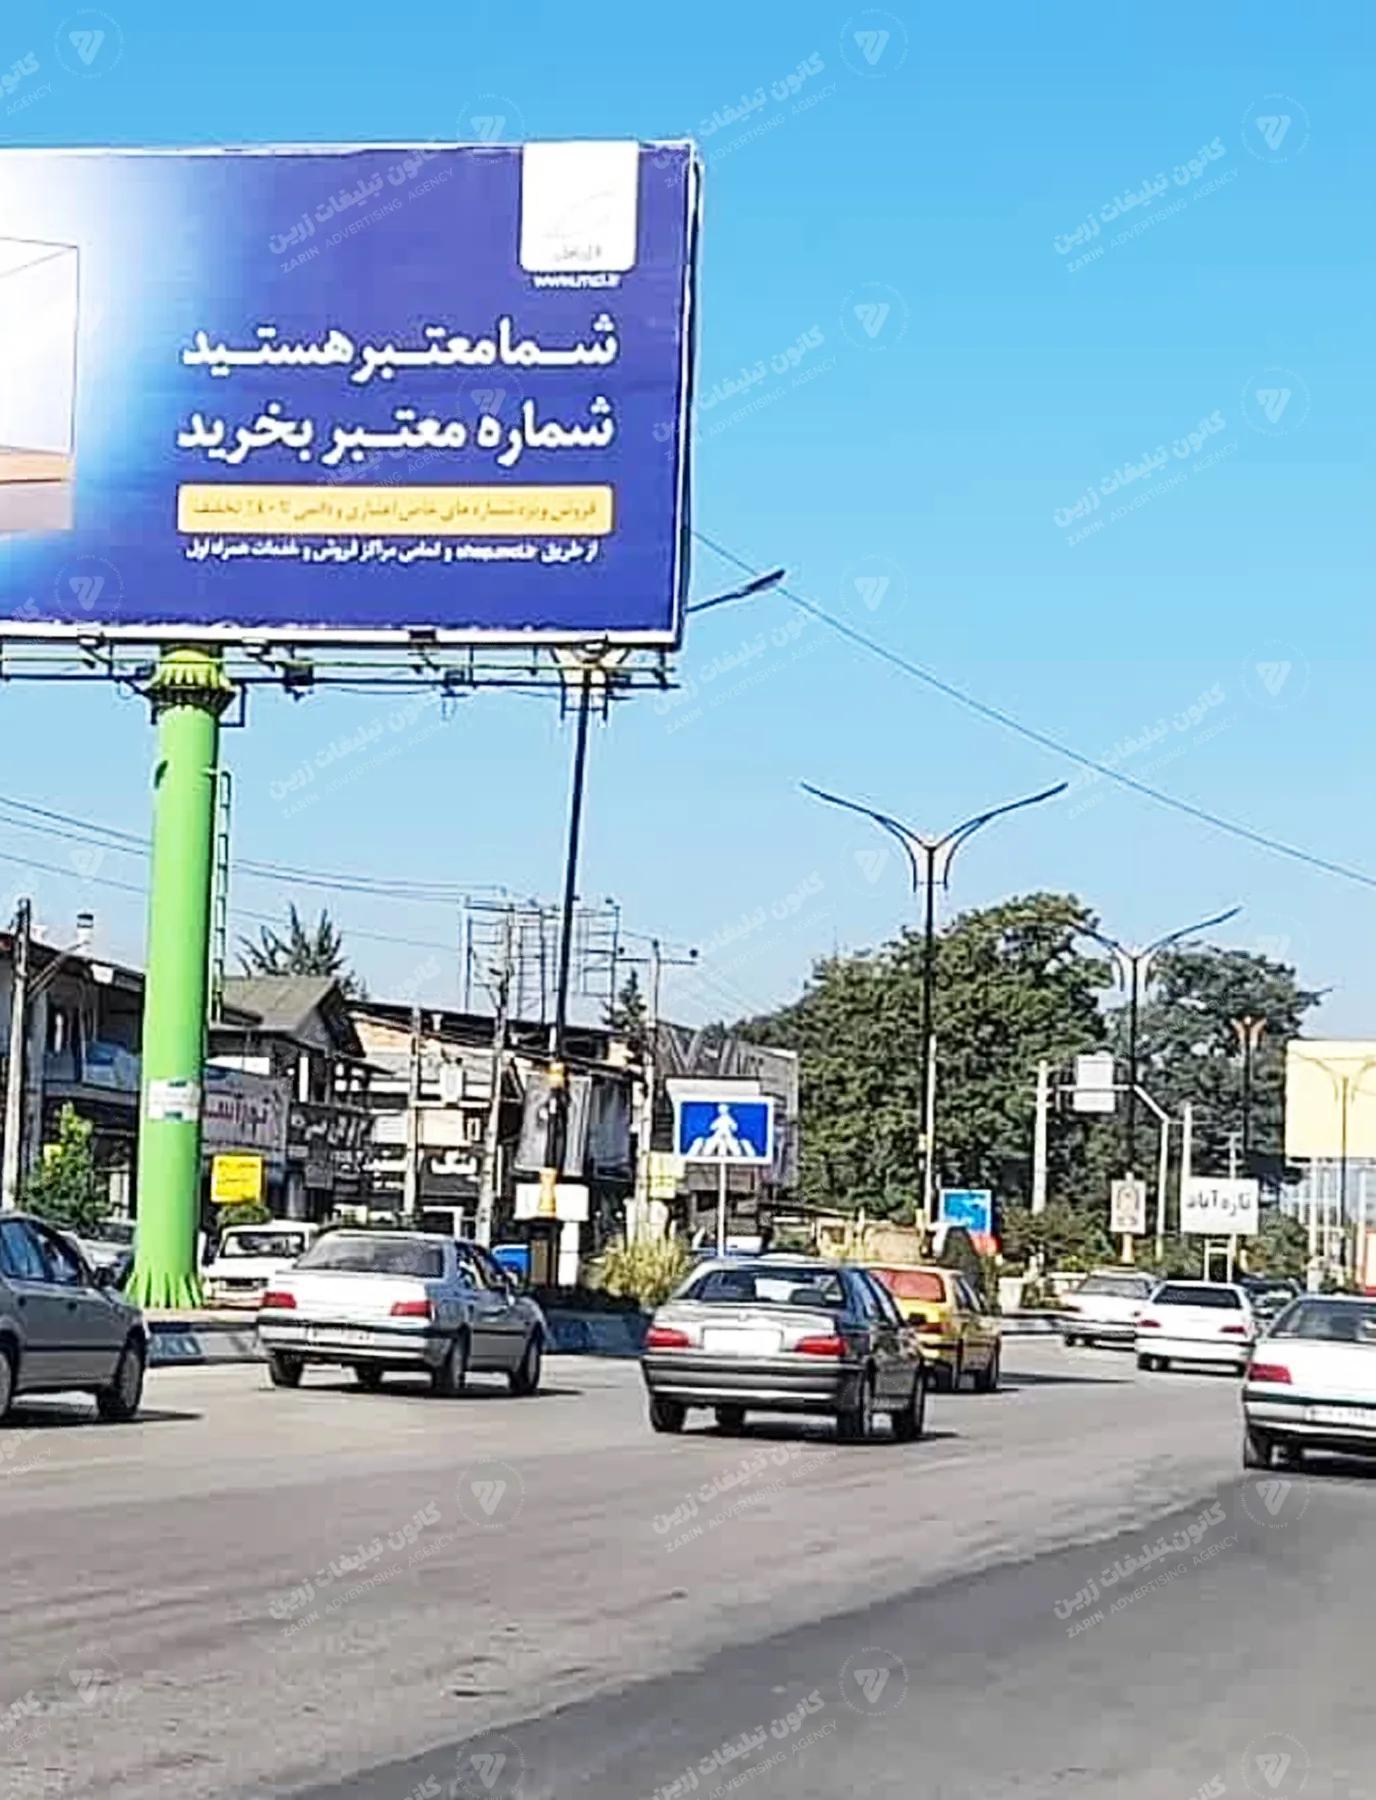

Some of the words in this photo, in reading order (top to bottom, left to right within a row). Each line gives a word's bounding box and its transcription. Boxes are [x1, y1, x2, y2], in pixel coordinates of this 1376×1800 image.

[182, 326, 352, 378] هستید
[350, 326, 496, 383] معتبر
[498, 312, 617, 366] شما
[177, 402, 312, 465] بخرید
[321, 408, 466, 465] معتبر
[476, 396, 614, 466] شماره
[1185, 1188, 1219, 1209] آباد
